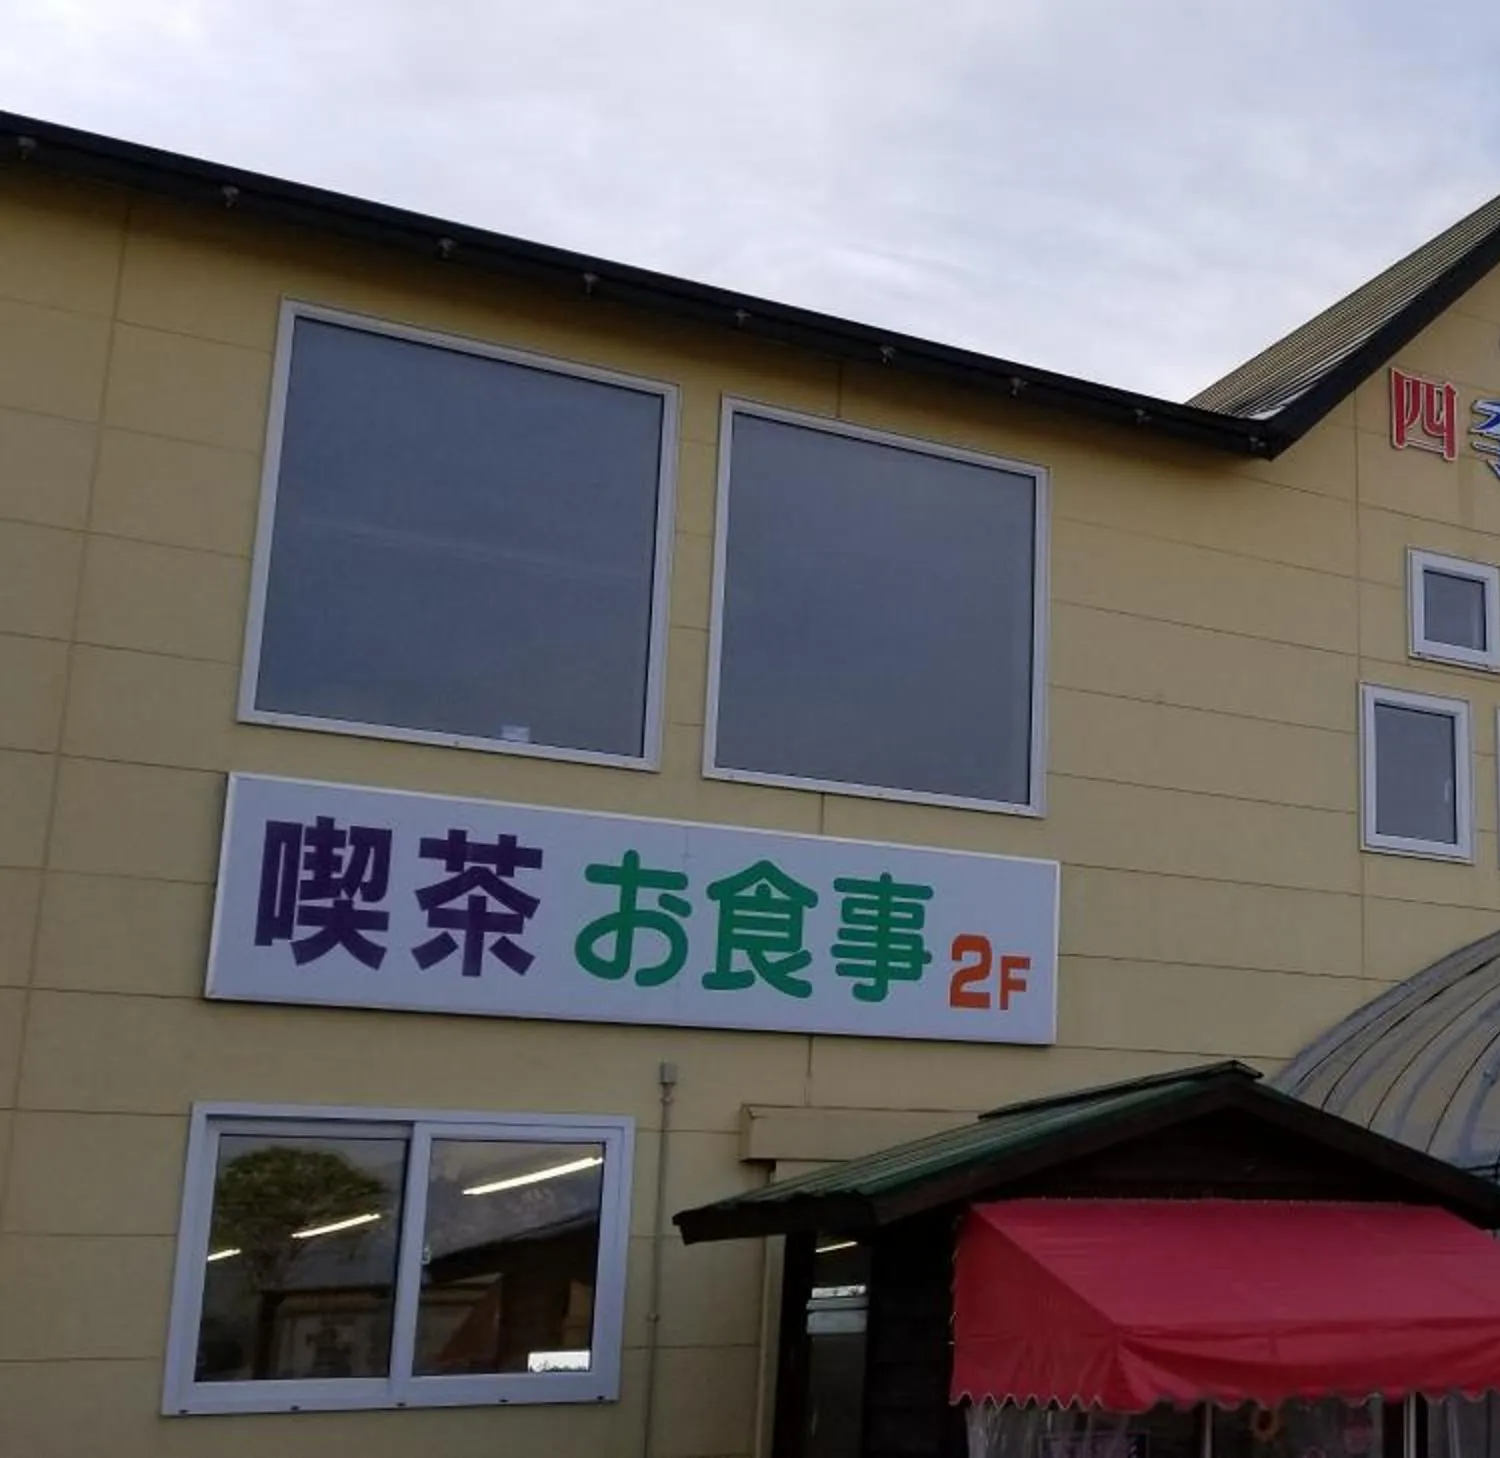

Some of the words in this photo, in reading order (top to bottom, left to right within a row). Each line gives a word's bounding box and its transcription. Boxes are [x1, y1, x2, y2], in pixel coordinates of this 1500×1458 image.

[255, 815, 543, 977] 喫茶
[574, 848, 934, 1002] お食事
[949, 933, 1031, 1011] 2F
